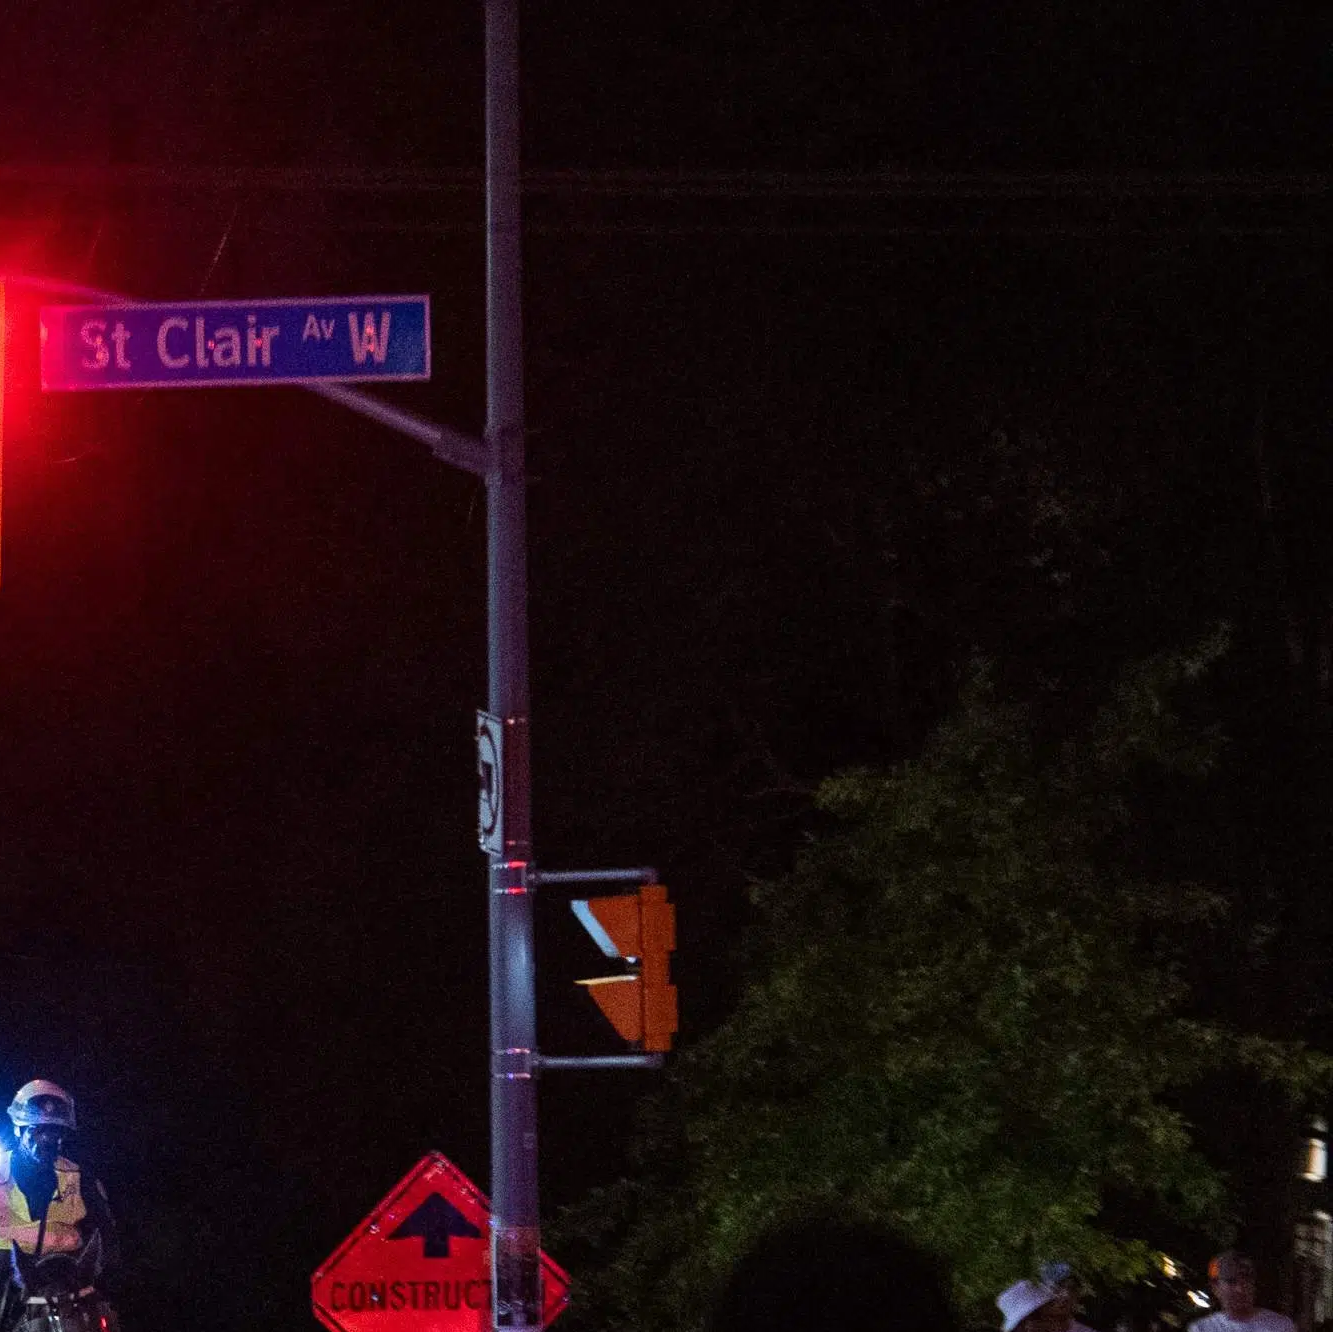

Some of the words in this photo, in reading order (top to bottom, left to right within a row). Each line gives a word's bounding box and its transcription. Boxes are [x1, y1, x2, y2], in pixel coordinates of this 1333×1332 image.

[80, 318, 132, 370] St
[156, 315, 280, 369] Clair
[302, 314, 335, 342] Av
[347, 311, 391, 365] W
[330, 1280, 494, 1313] CONSTRUCT
